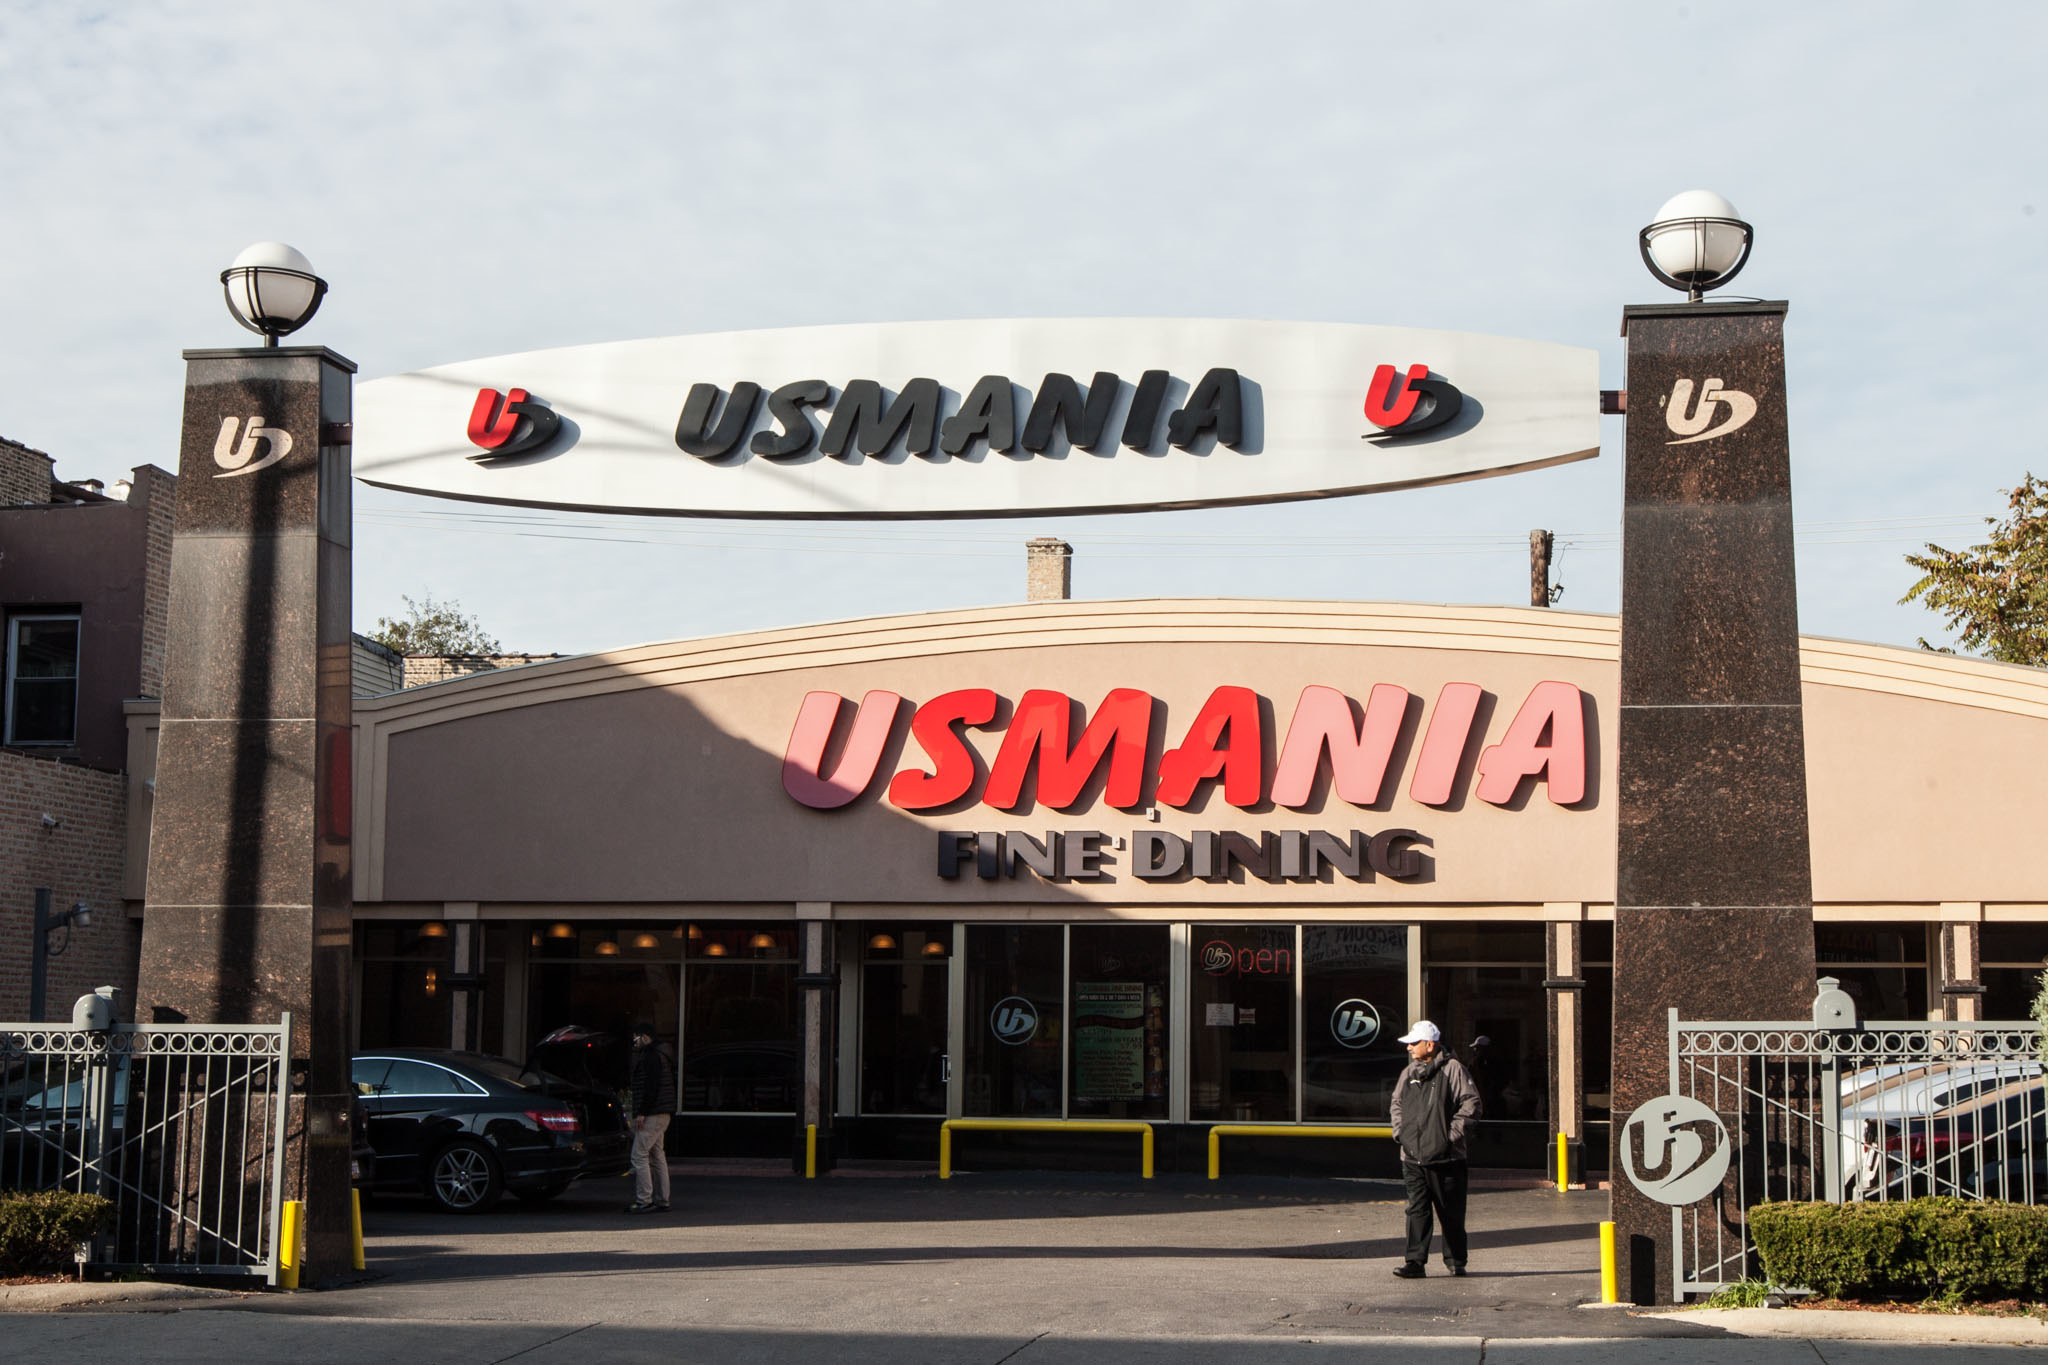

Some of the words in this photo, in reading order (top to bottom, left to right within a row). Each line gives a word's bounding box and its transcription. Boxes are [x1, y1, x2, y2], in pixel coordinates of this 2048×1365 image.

[675, 367, 1243, 458] USMANIA
[781, 680, 1586, 811] USMANIA
[937, 829, 1101, 879] FINE
[1131, 827, 1423, 879] DINING
